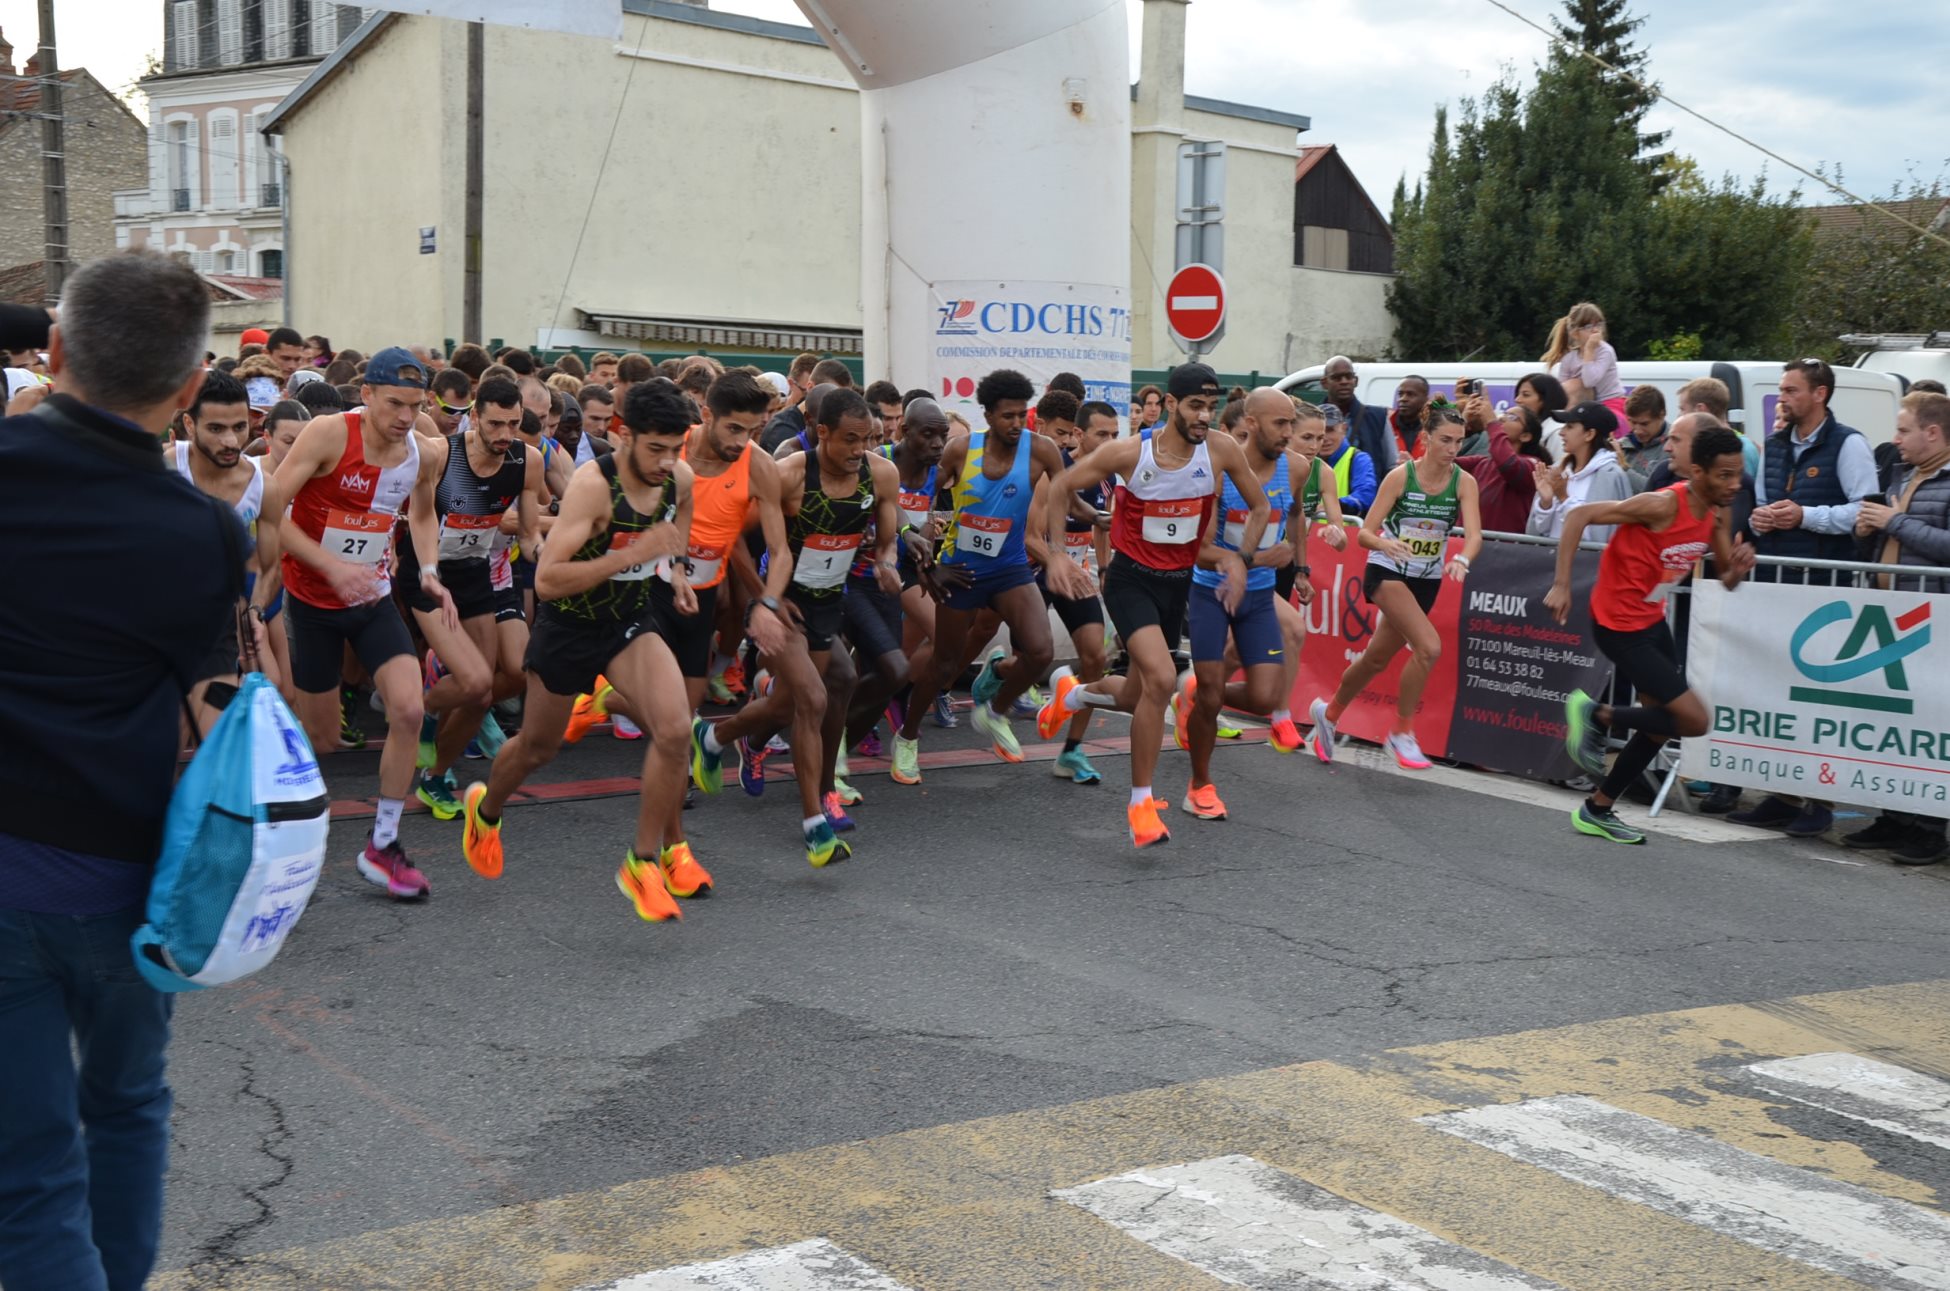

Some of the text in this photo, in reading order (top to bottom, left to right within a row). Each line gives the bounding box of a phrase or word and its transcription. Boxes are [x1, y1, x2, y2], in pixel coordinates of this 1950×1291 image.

[980, 301, 1102, 336] CDCHS
[936, 346, 998, 358] COMMISSION
[340, 472, 370, 491] NAM
[1167, 522, 1177, 537] 9
[342, 538, 368, 555] 27
[459, 534, 479, 546] 13
[973, 535, 992, 551] 96
[824, 557, 833, 570] 1
[1469, 590, 1528, 618] MEAUX
[1484, 619, 1503, 635] Rue
[1504, 622, 1521, 638] des
[1467, 636, 1502, 653] 77100
[1466, 655, 1544, 680] 01 64 53 38 82
[1713, 705, 1797, 742] BRIE
[1709, 748, 1946, 801] Banque & Assura
